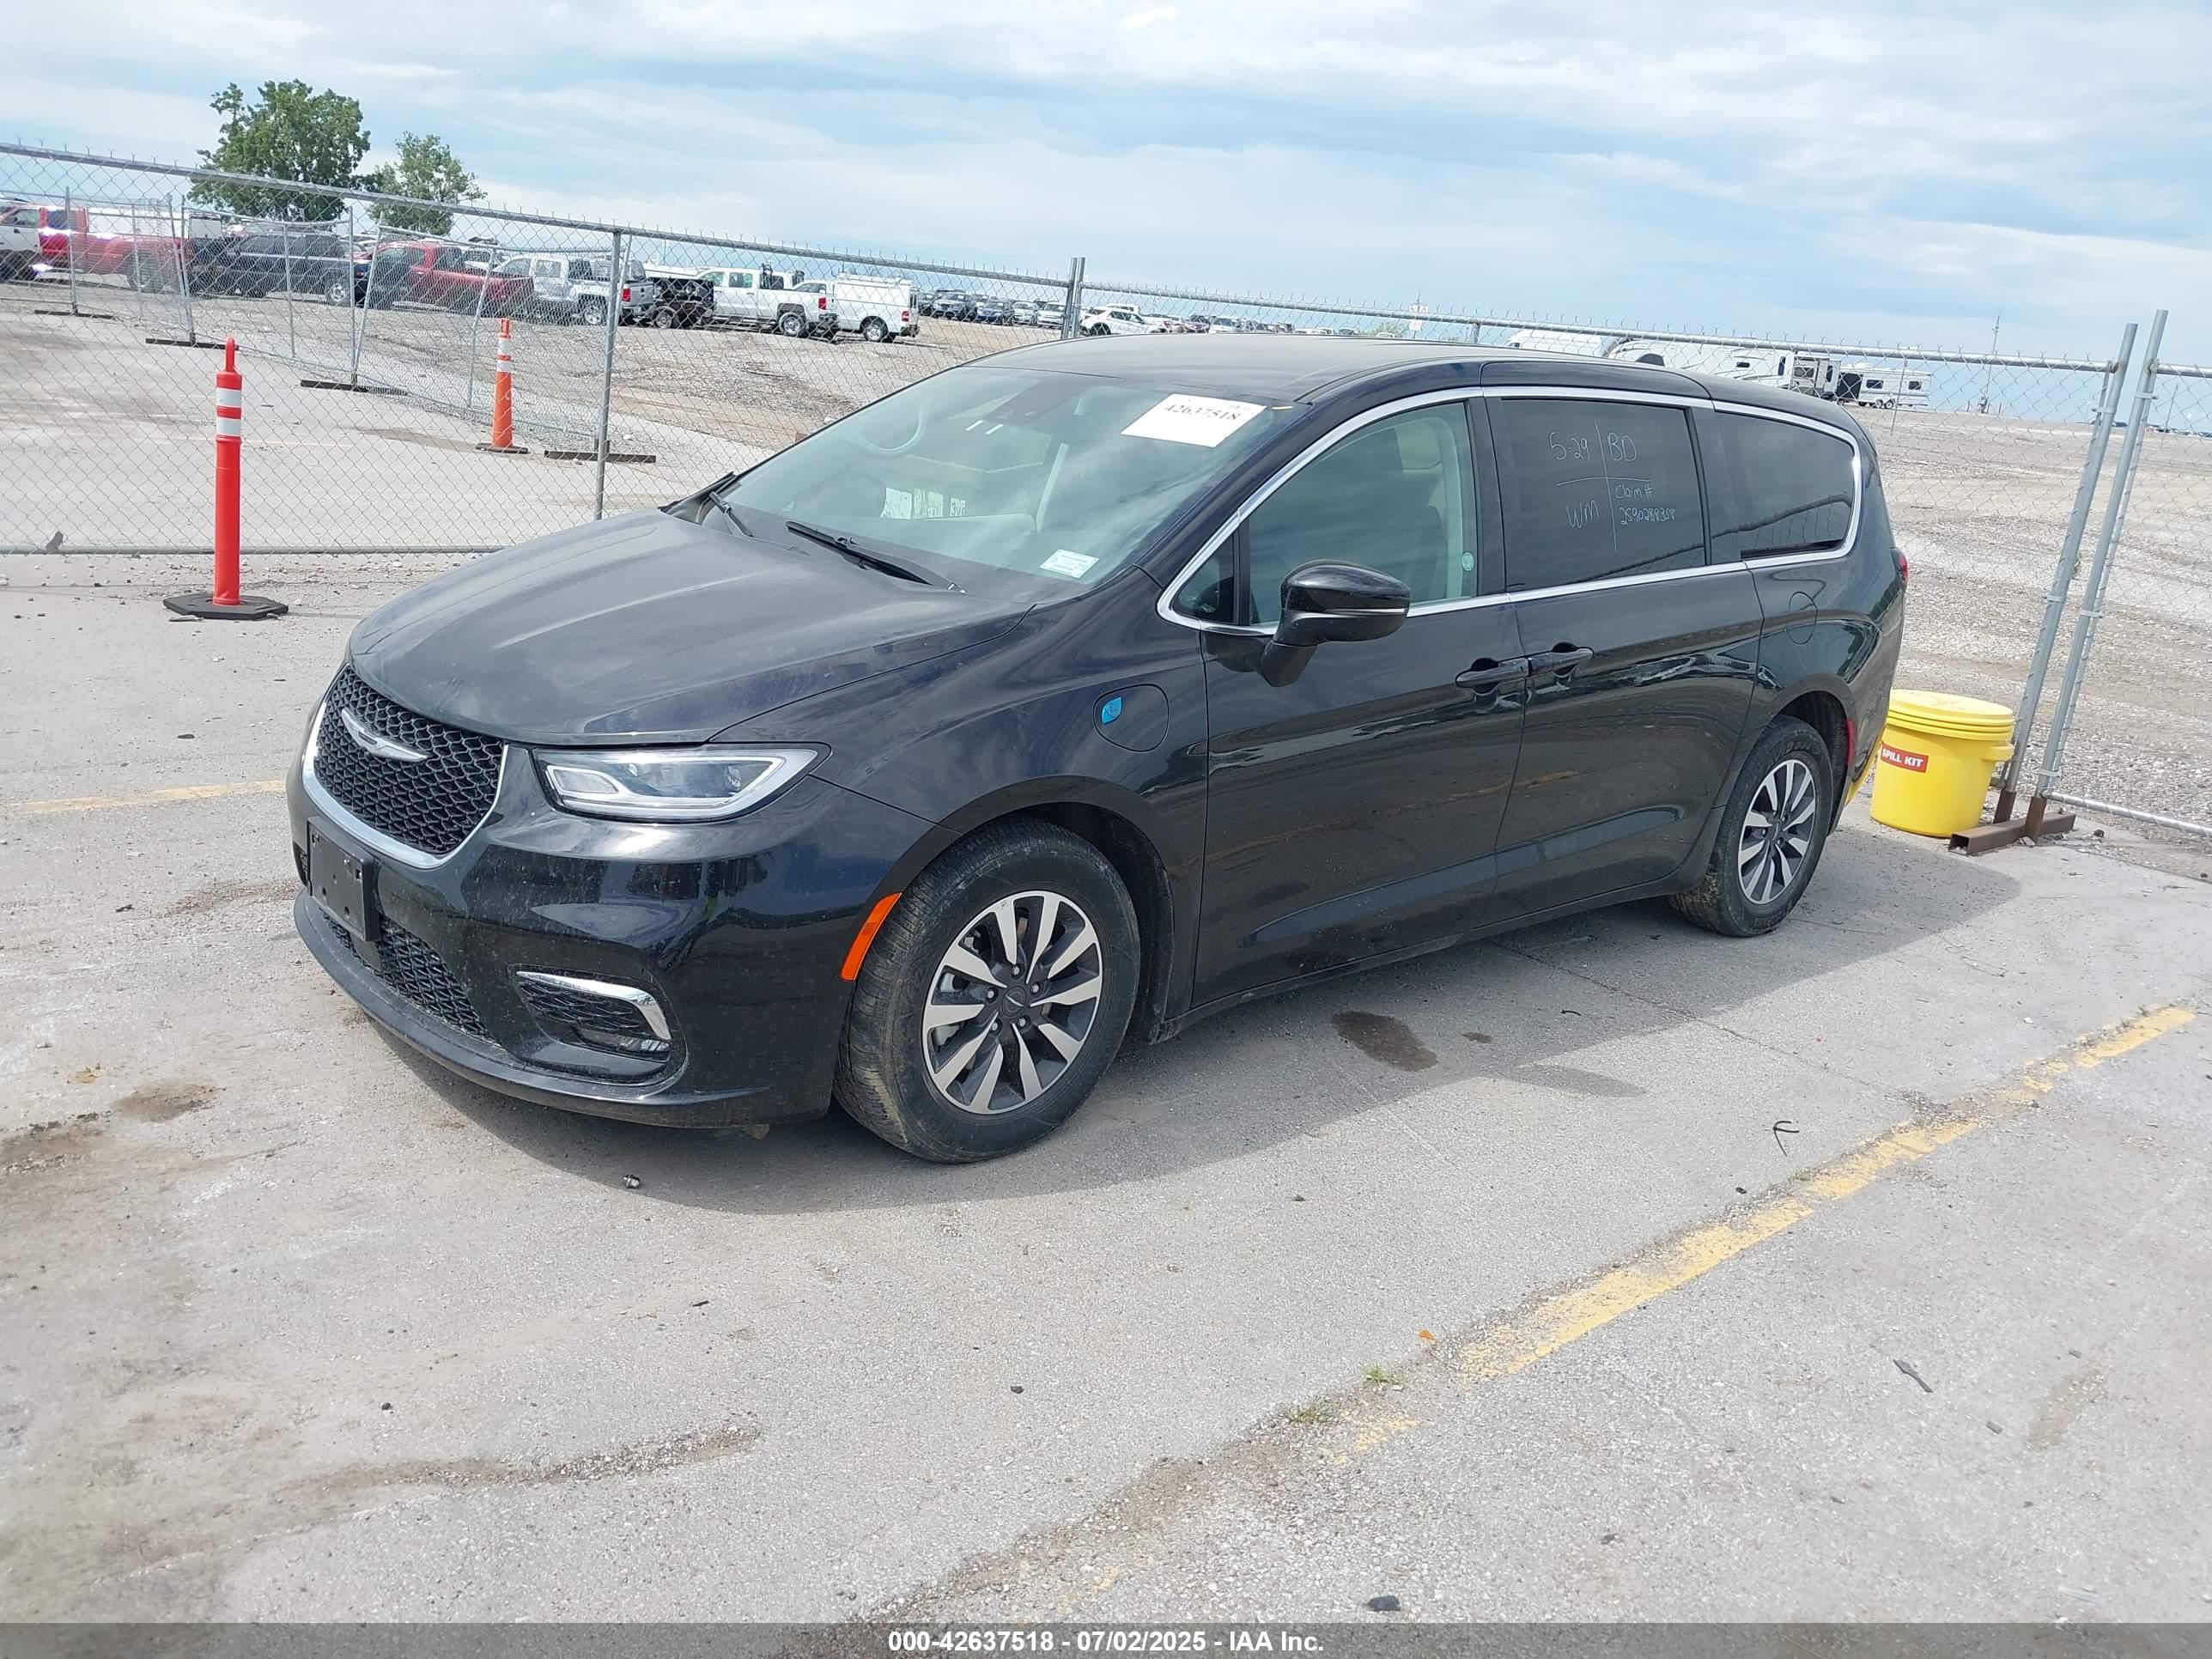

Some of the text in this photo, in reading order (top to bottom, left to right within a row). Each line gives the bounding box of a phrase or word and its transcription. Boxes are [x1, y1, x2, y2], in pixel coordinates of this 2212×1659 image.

[1549, 431, 1590, 460] 5-29
[1607, 432, 1637, 461] BD
[1614, 483, 1654, 499] Claim #
[1882, 749, 1924, 768] SPILL KIT
